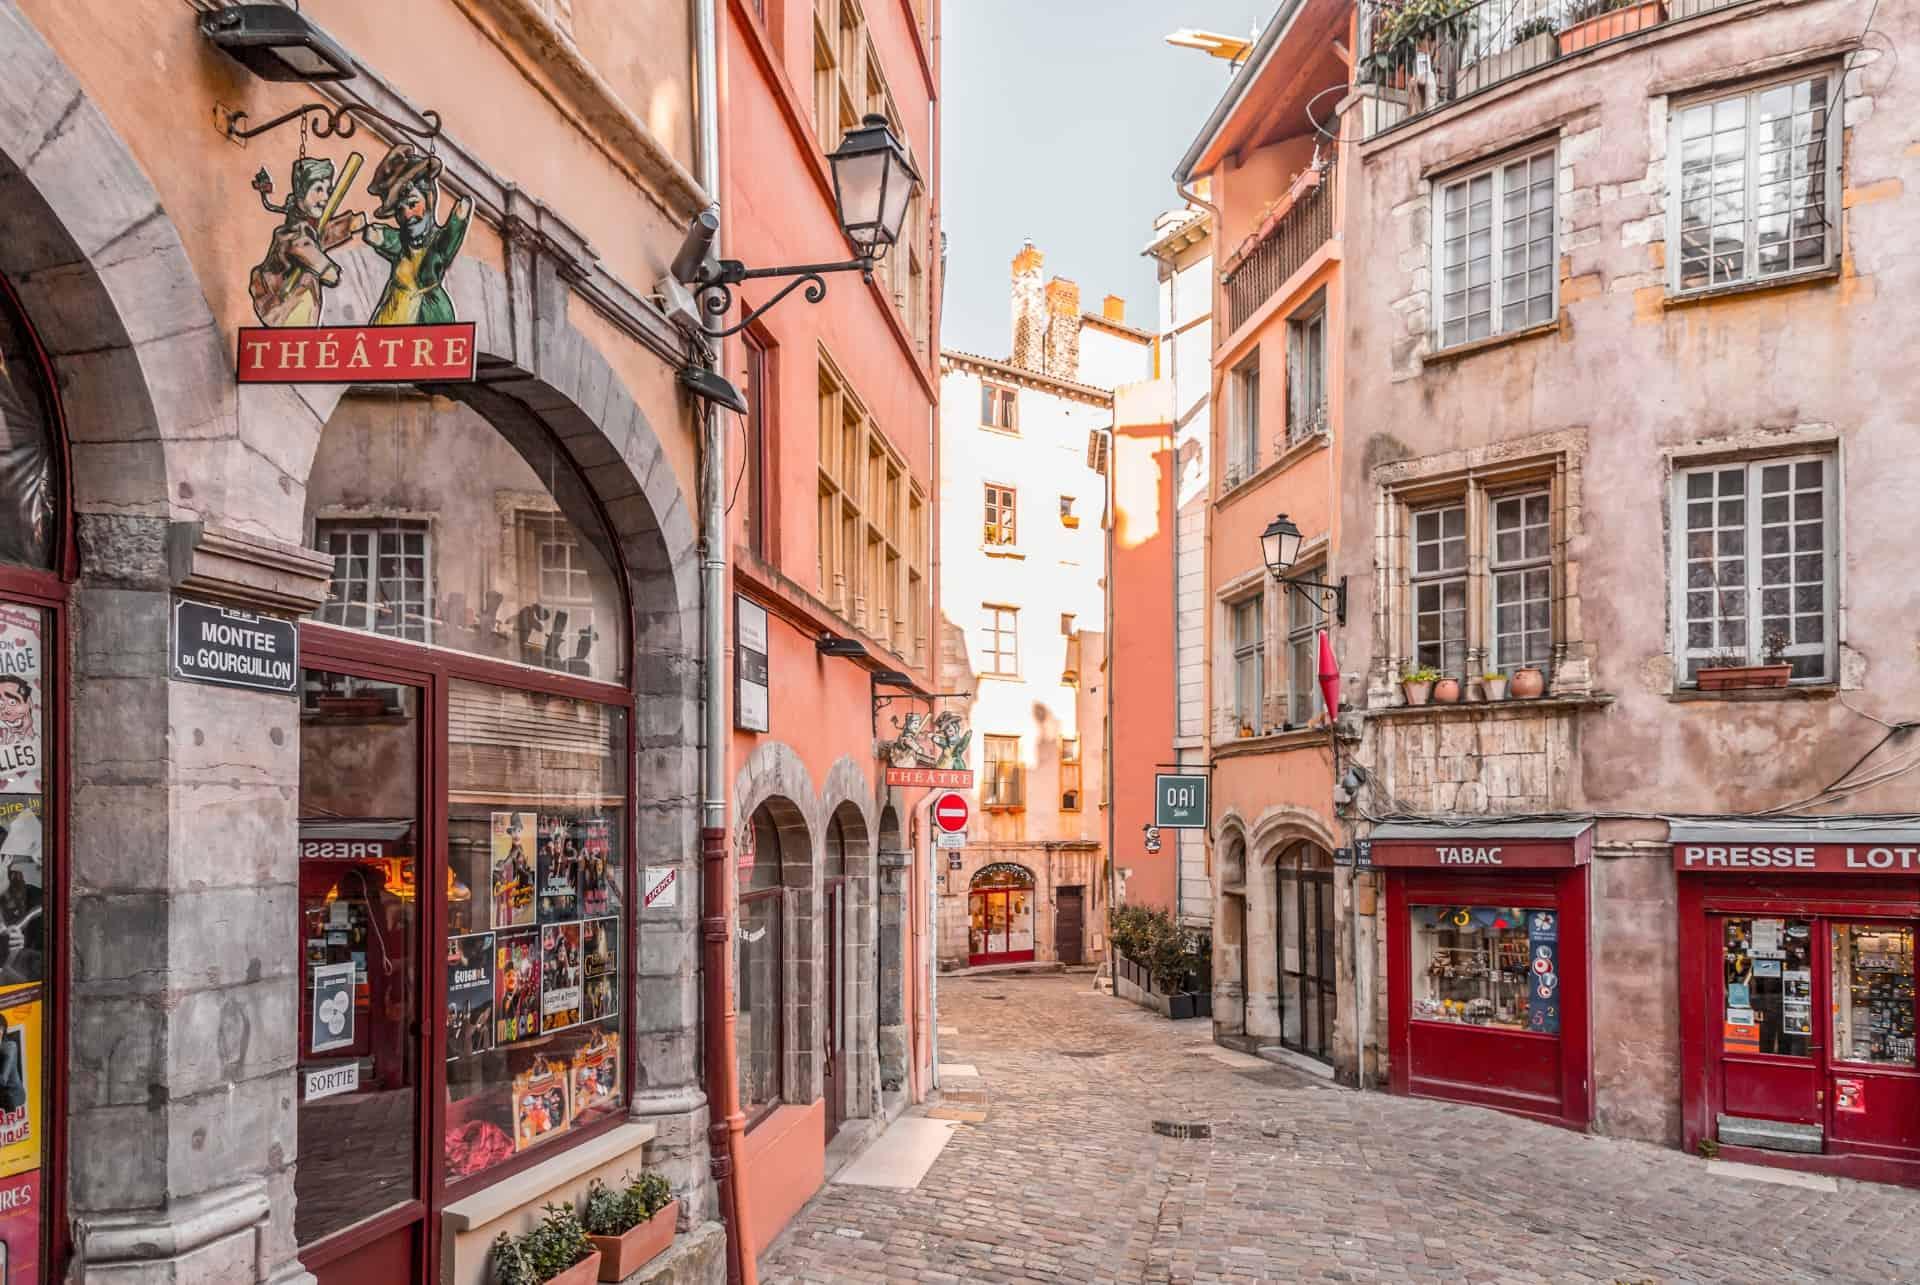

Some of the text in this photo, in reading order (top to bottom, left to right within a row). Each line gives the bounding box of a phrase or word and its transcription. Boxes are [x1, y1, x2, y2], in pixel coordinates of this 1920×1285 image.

[246, 331, 468, 369] THÉÂTRE
[201, 621, 276, 653] MONTEE
[183, 648, 291, 681] DU GOURGUILLON
[888, 770, 970, 785] THÉÂTRE
[1435, 847, 1503, 864] TABAC
[1684, 847, 1920, 868] PRESSE LOT
[310, 1069, 354, 1093] SORTIE
